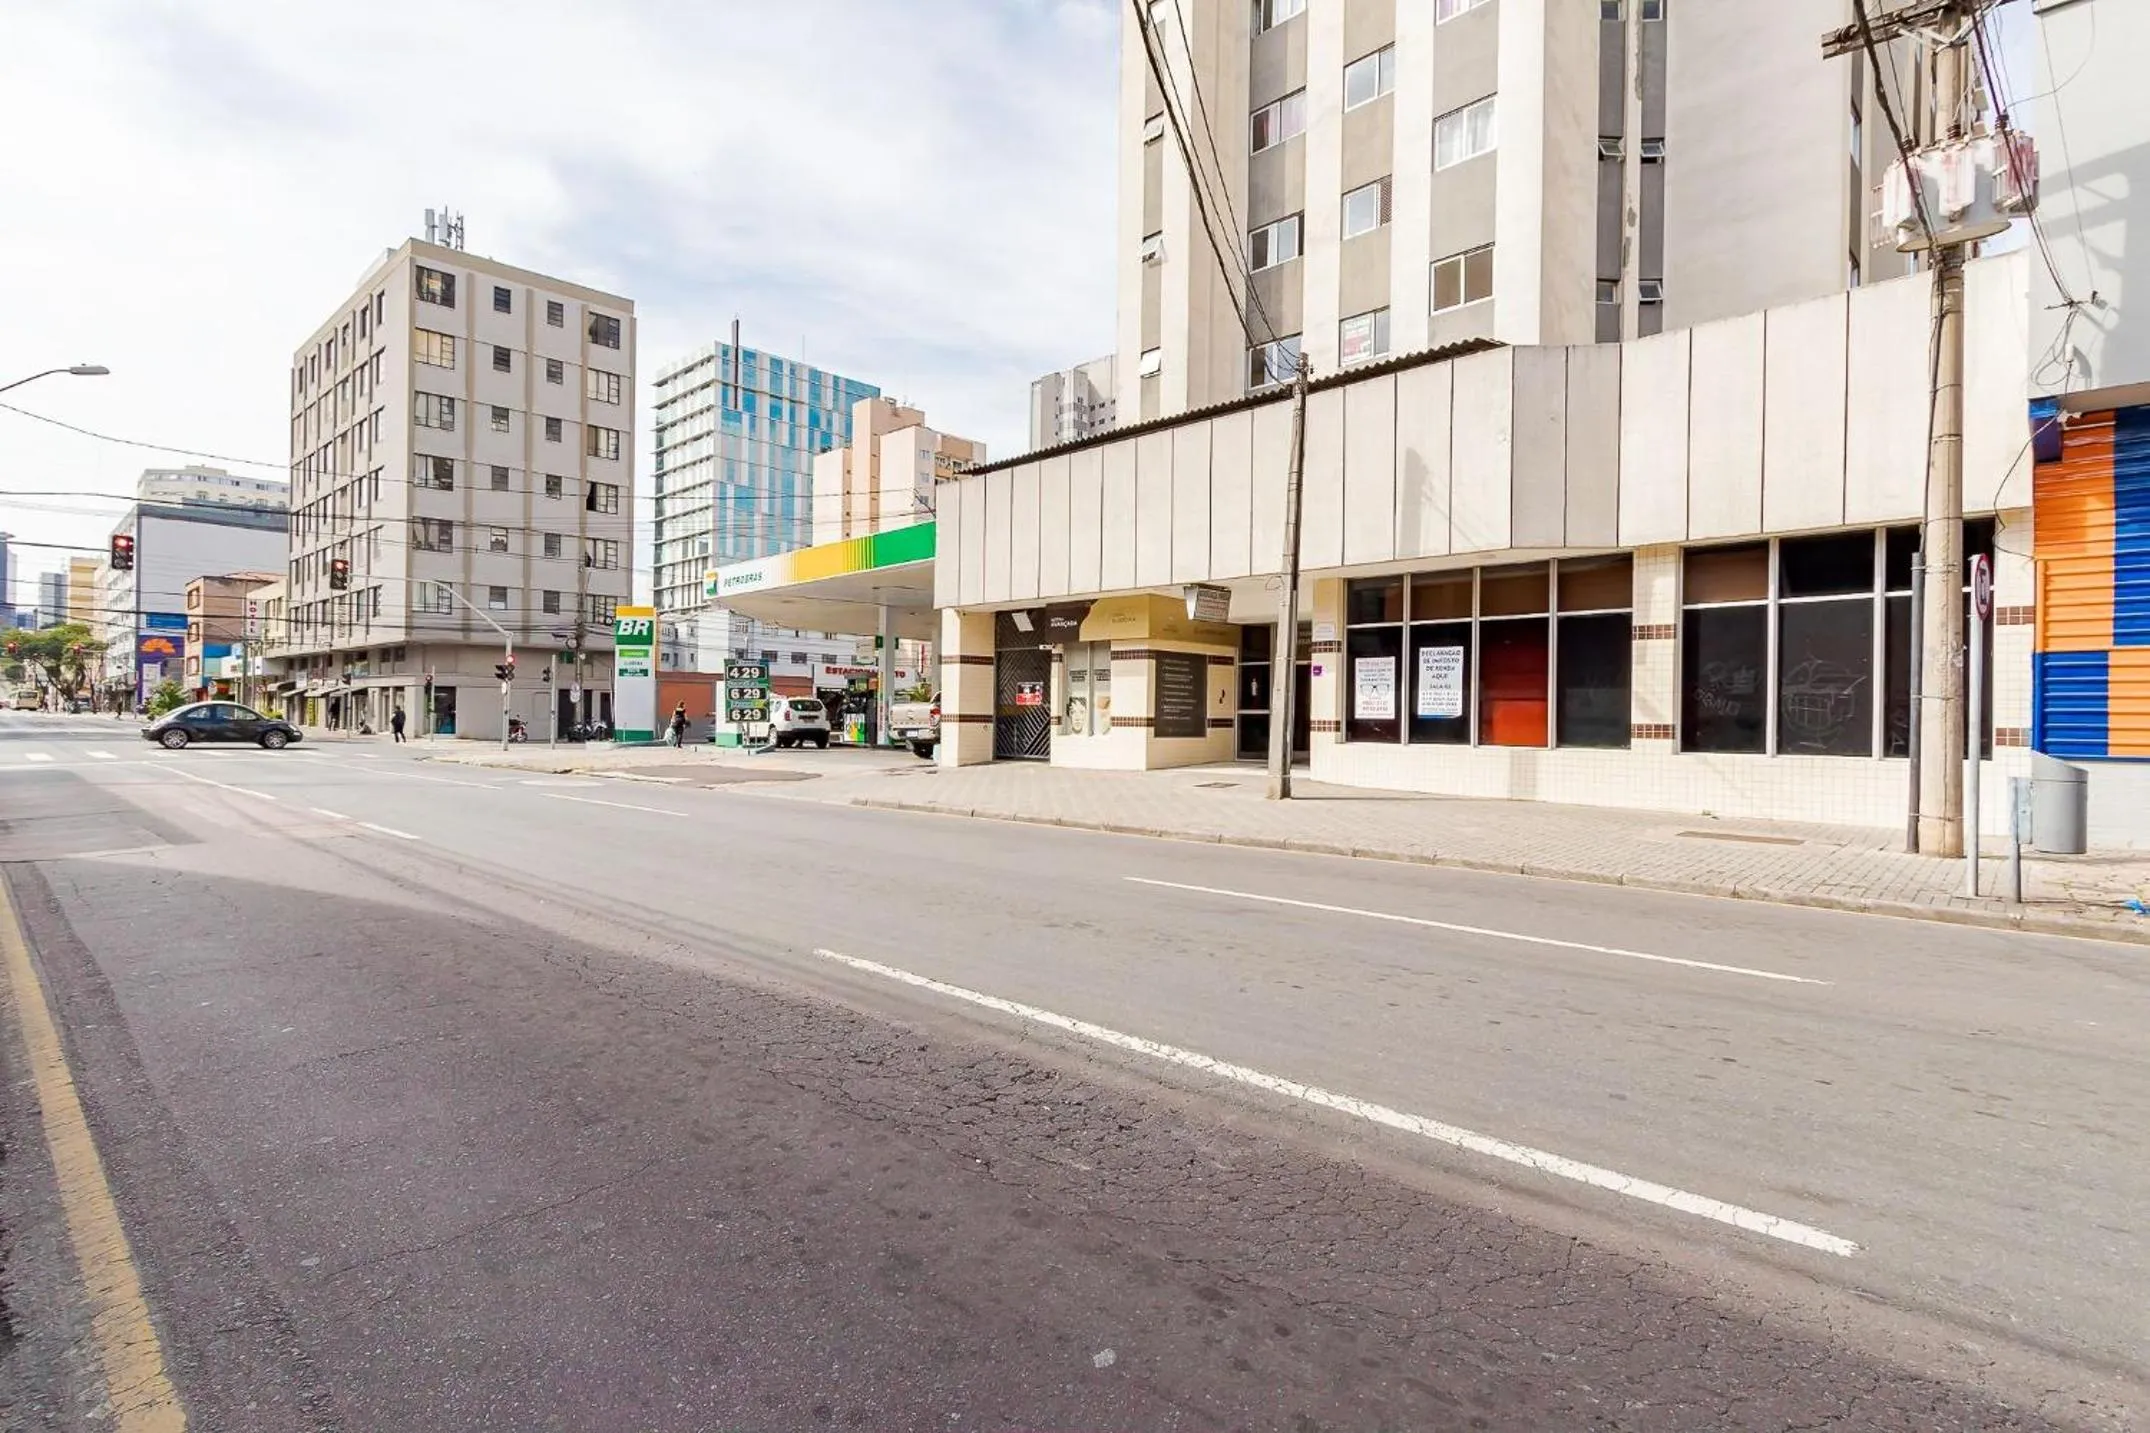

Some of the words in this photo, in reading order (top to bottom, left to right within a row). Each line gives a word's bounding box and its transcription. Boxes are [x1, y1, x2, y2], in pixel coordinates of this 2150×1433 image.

[723, 571, 763, 587] PETROBRAS
[249, 600, 257, 633] HOTEL
[617, 619, 650, 636] BR
